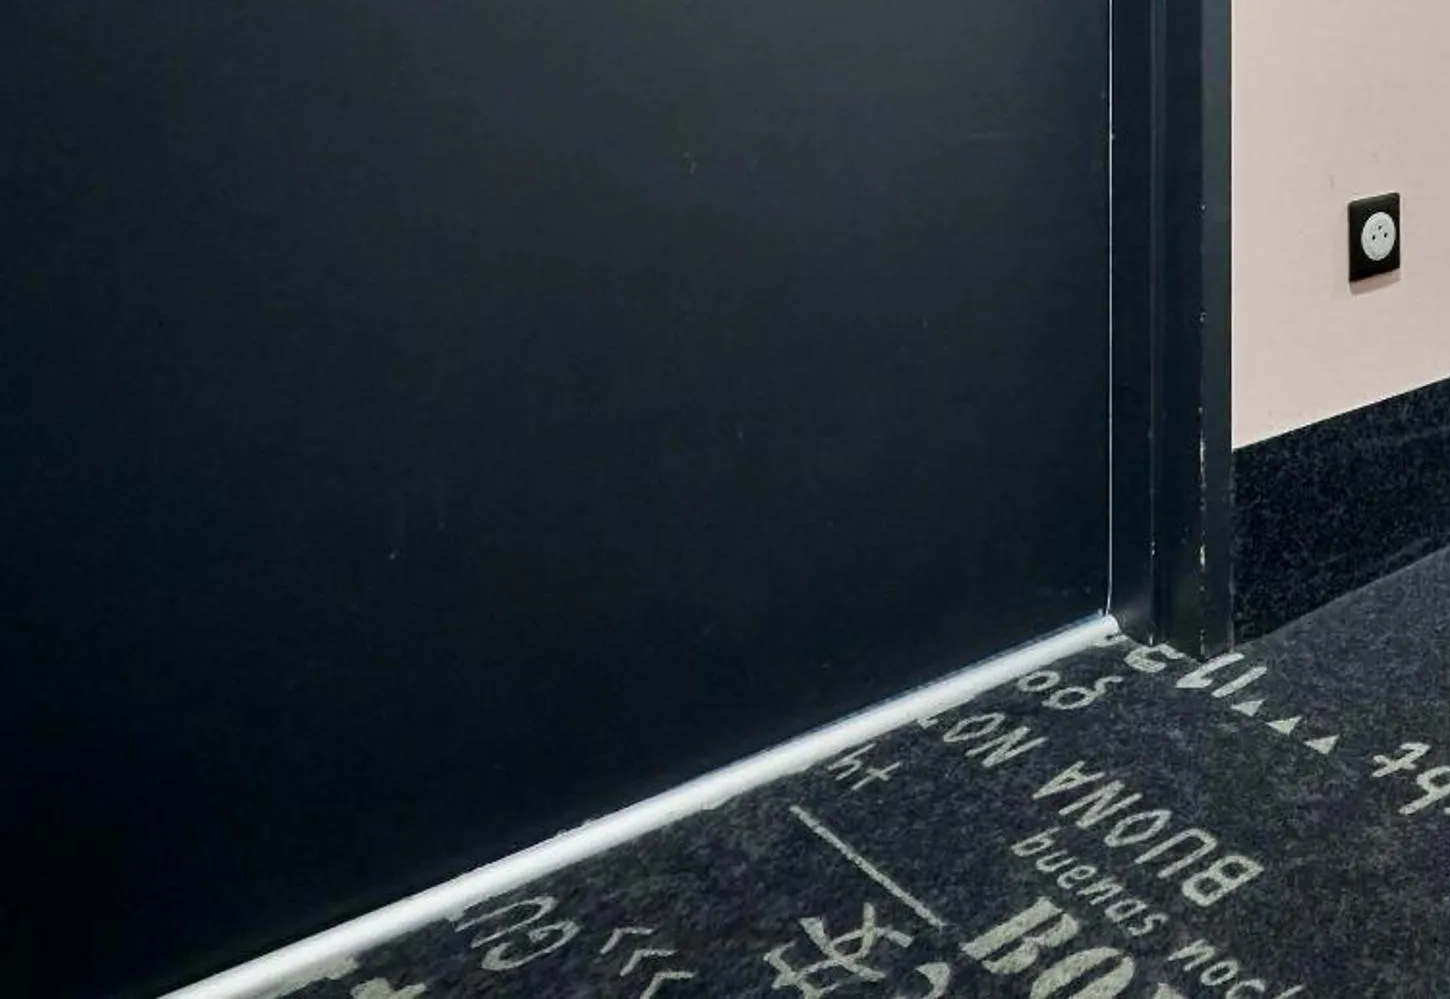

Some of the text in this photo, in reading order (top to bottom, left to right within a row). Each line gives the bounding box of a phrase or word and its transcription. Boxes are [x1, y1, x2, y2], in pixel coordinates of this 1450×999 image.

[1032, 760, 1265, 907] BUONA
[958, 896, 1186, 999] BO
[1010, 826, 1306, 999] buenas noc
